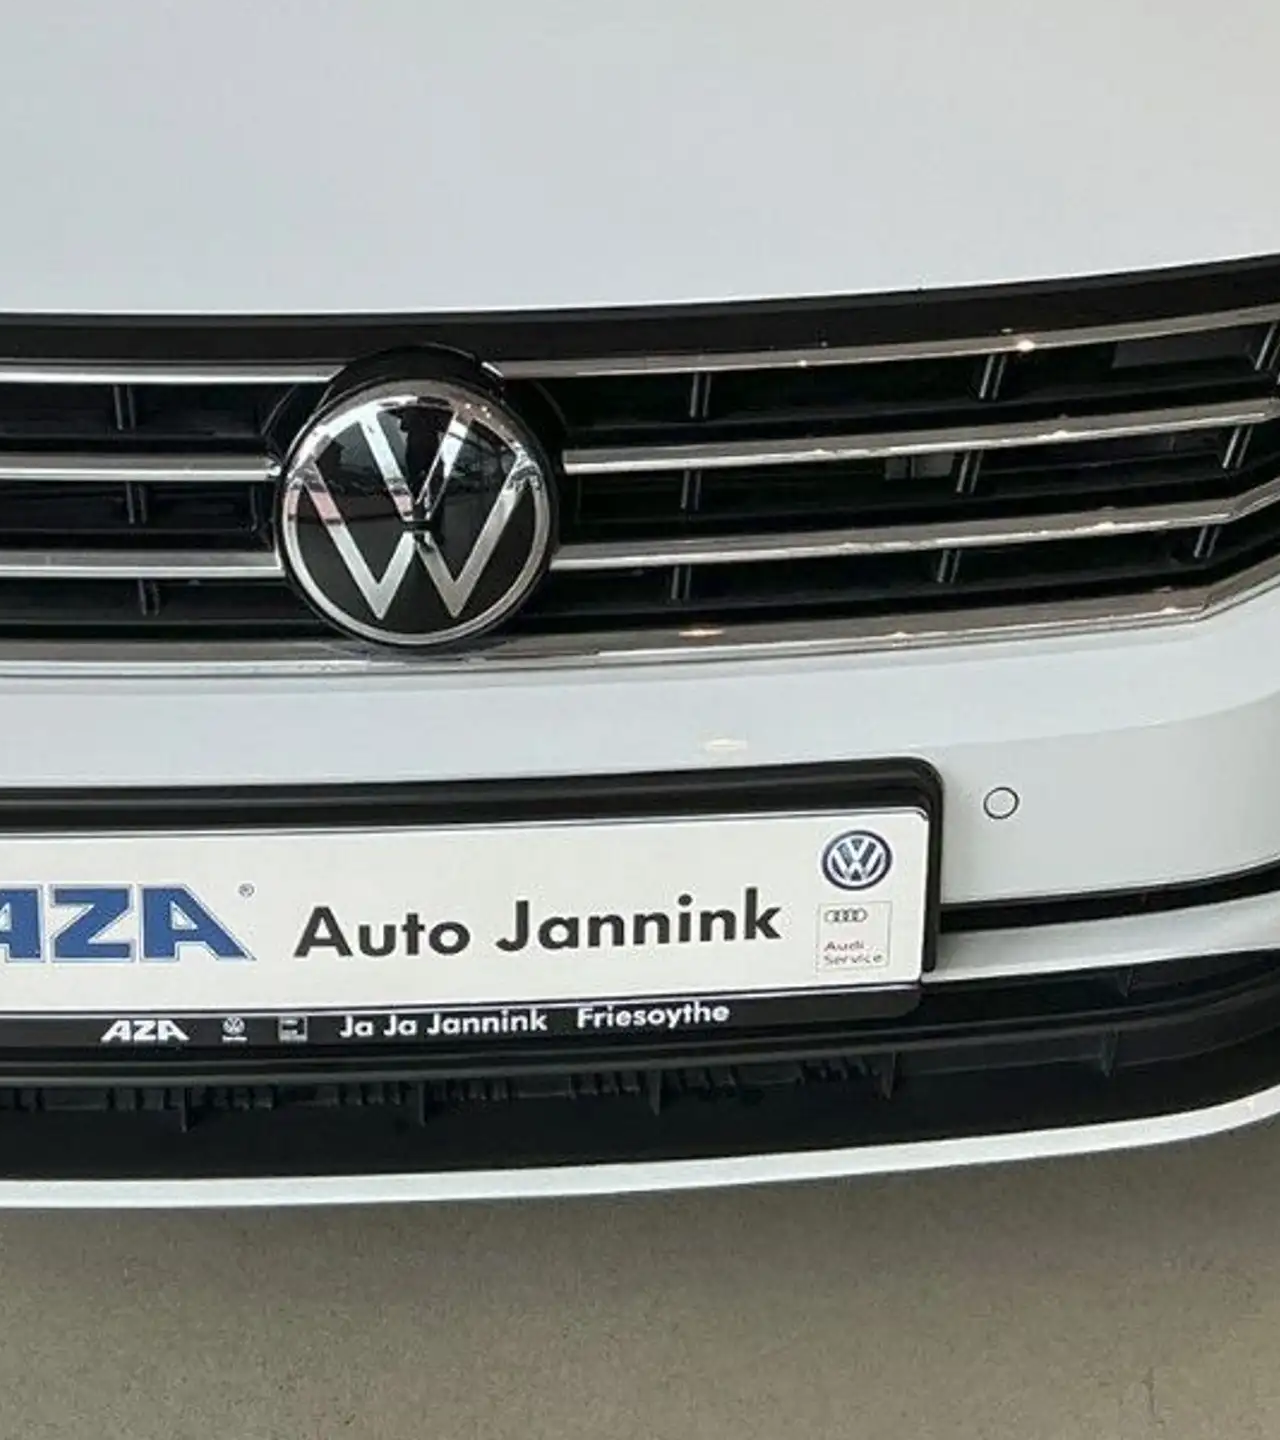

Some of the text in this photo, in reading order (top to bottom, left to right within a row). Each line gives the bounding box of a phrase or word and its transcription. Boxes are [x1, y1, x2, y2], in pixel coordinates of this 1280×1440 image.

[294, 886, 782, 957] Auto Jannink
[823, 940, 865, 951] Audi
[101, 1019, 190, 1042] AZA
[339, 1001, 731, 1038] Ja Ja Jannink Friesoythe
